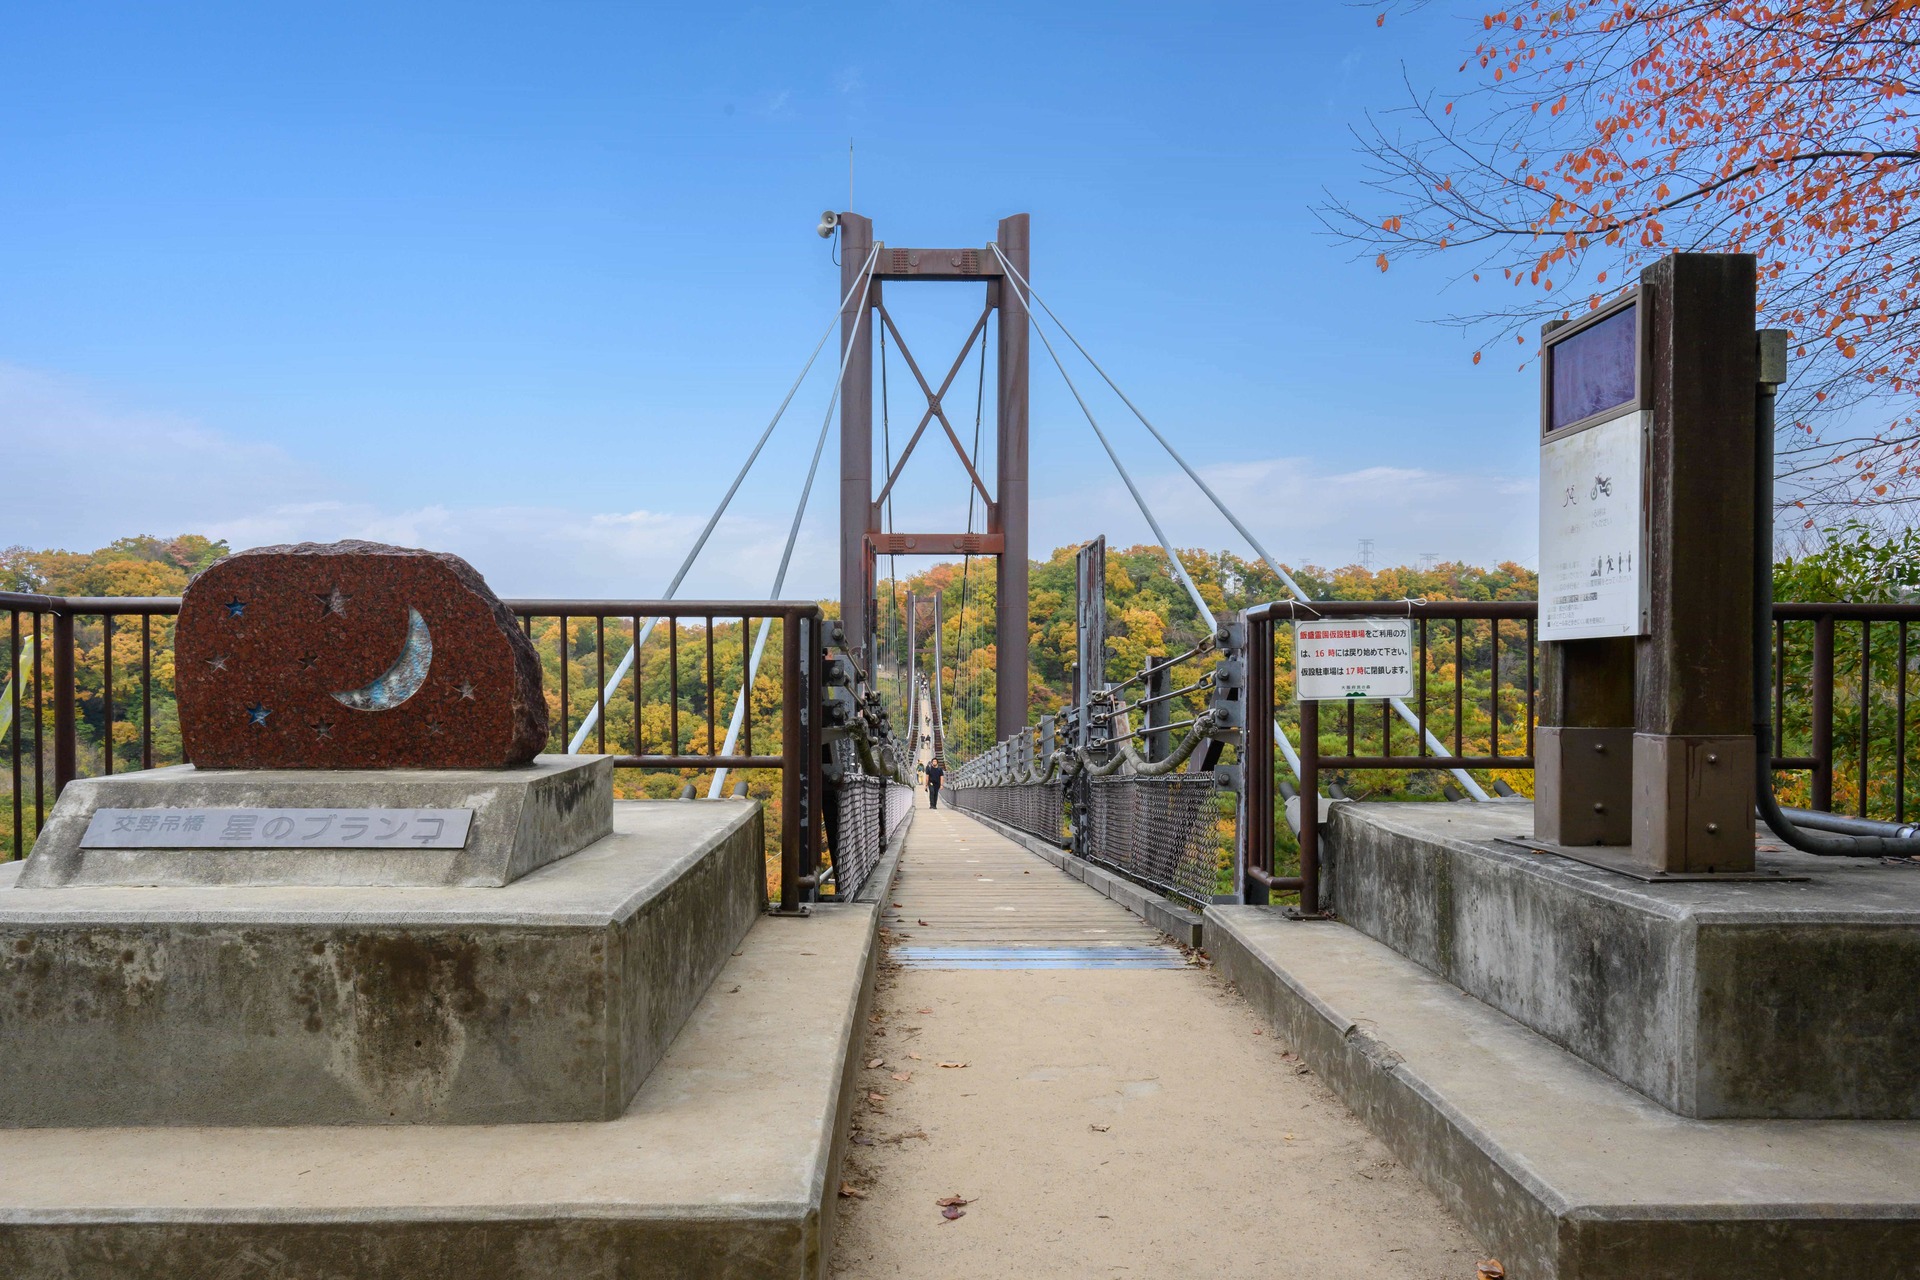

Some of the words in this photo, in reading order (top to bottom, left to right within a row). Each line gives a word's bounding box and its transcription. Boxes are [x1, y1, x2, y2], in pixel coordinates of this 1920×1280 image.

[112, 815, 206, 832] 交野吊橋
[219, 814, 445, 841] 星のブランコ
